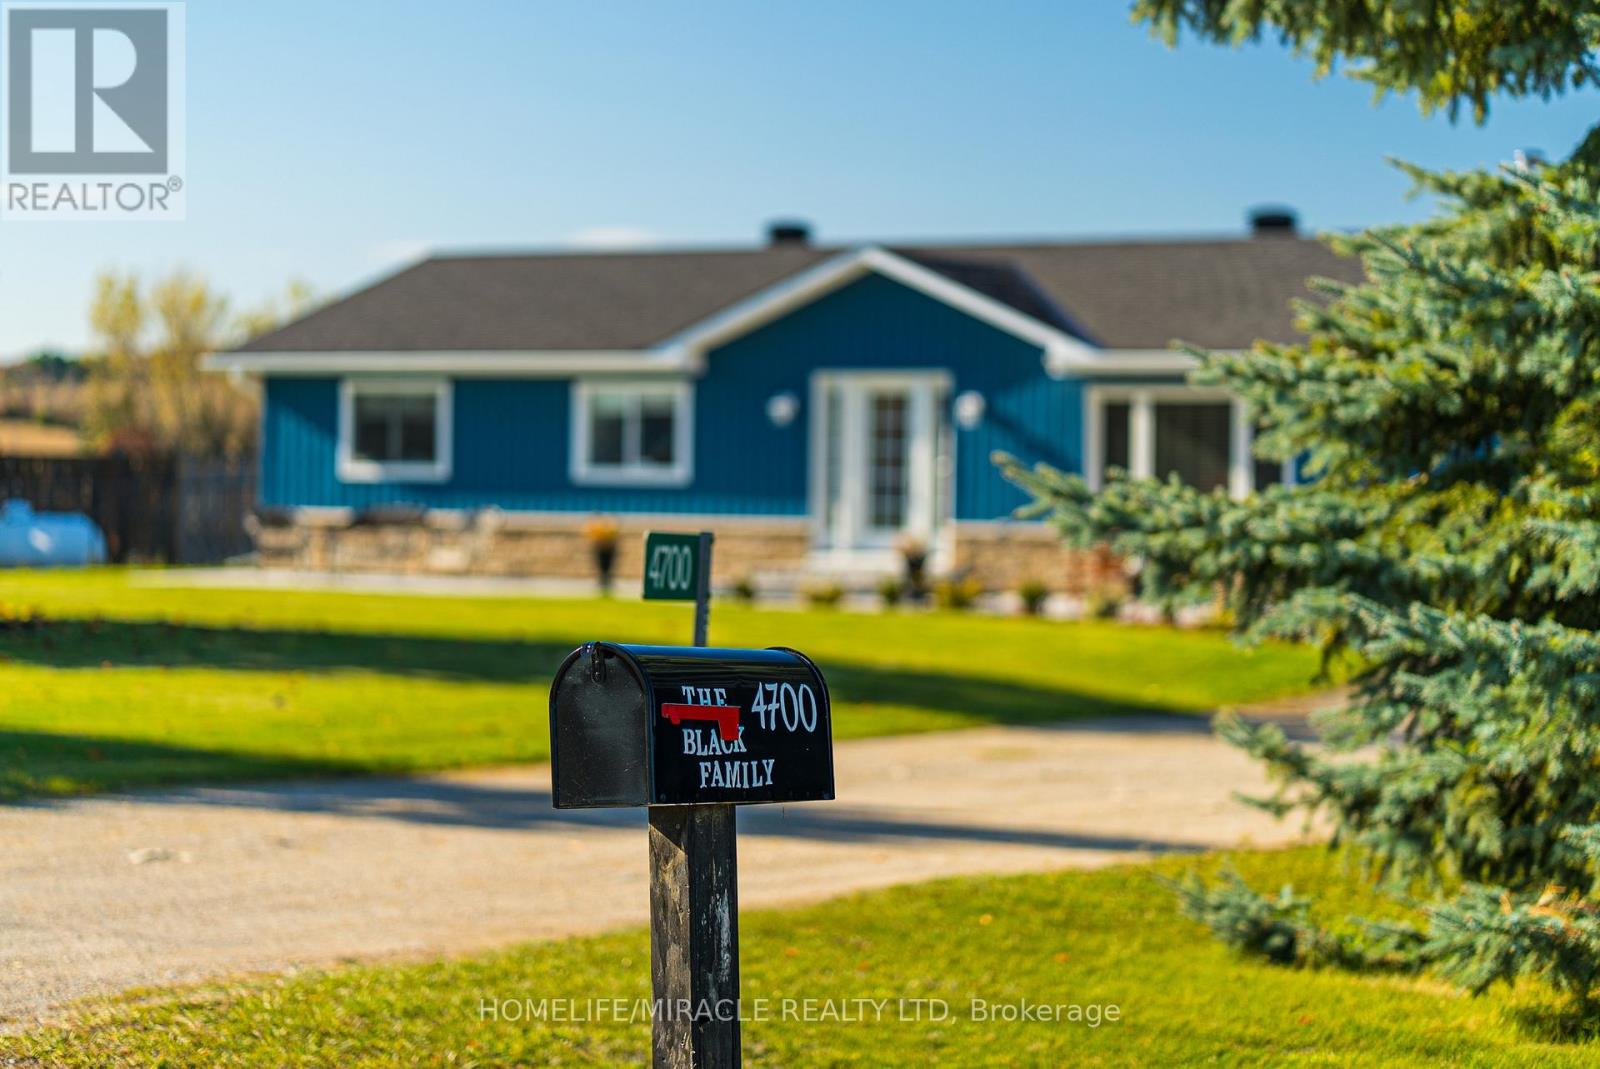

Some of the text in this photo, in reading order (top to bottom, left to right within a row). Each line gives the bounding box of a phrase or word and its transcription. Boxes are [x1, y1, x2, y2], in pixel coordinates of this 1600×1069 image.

[649, 544, 693, 591] 4700
[681, 685, 728, 706] THE
[751, 681, 818, 733] 4700
[699, 759, 775, 789] FAMILY
